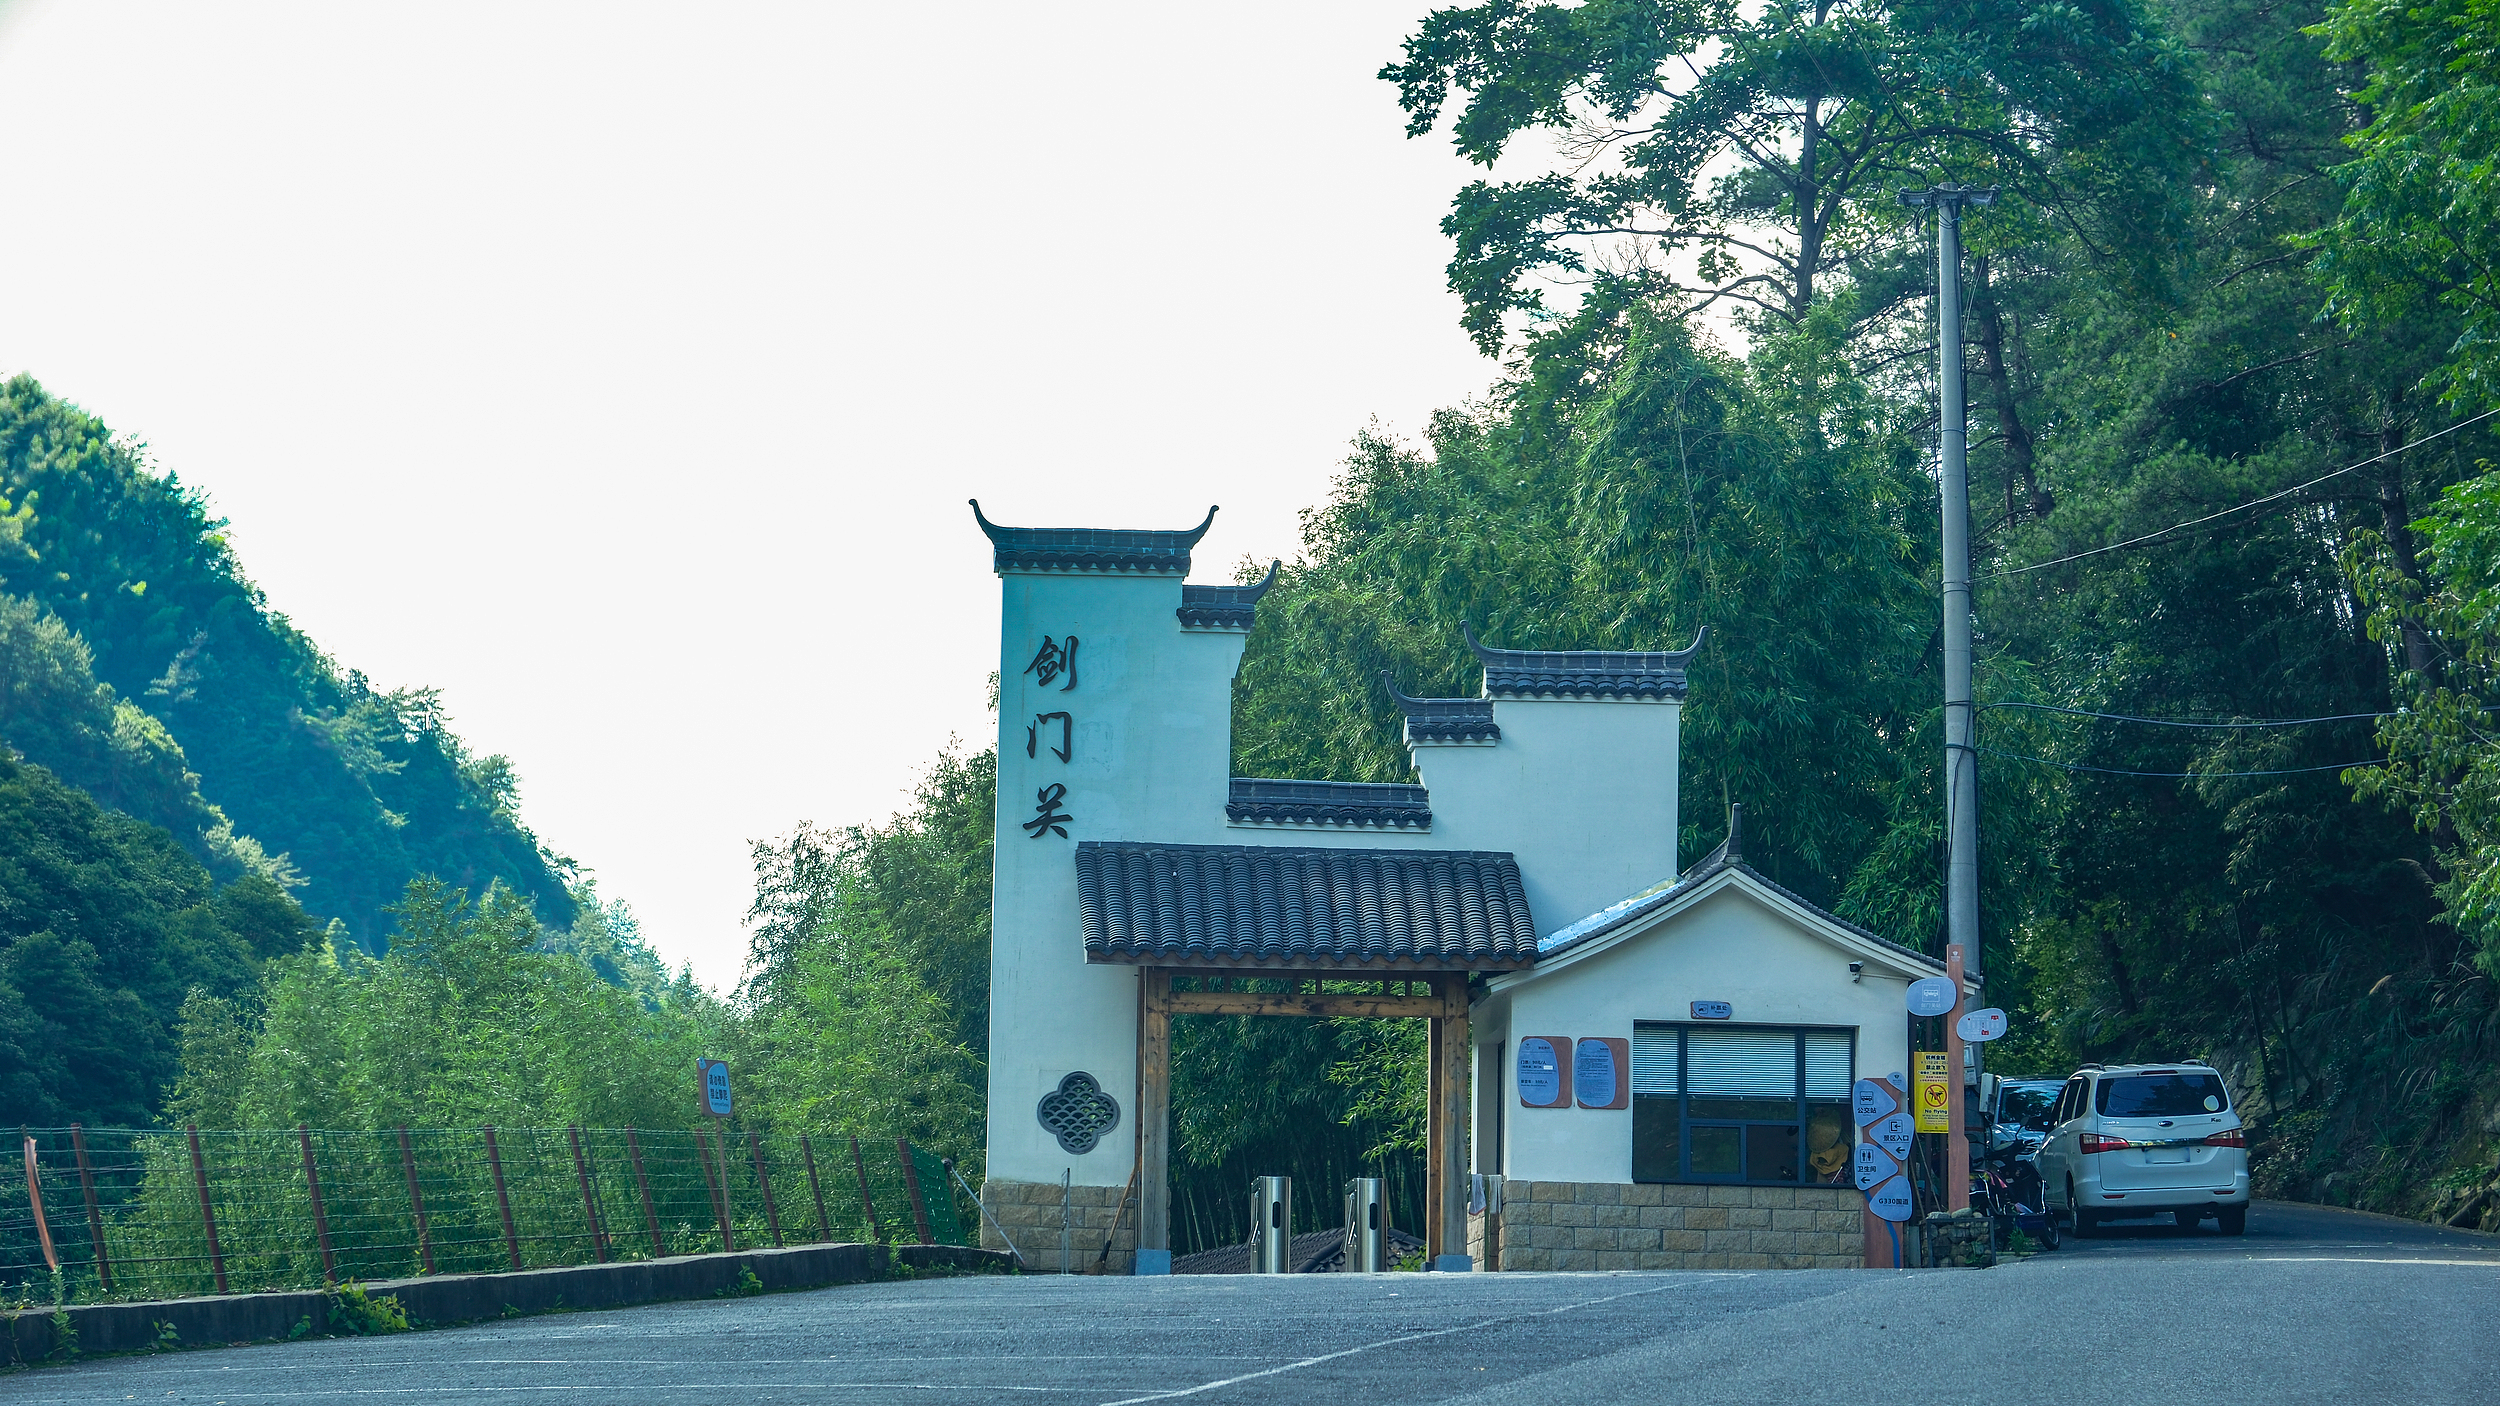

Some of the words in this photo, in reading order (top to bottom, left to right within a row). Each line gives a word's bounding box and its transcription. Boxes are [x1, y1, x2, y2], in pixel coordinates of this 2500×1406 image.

[1023, 634, 1080, 840] 剑门关
[1857, 1106, 1877, 1114] 公交站
[1883, 1134, 1910, 1142] 景区入口
[1857, 1165, 1877, 1173] 卫生间
